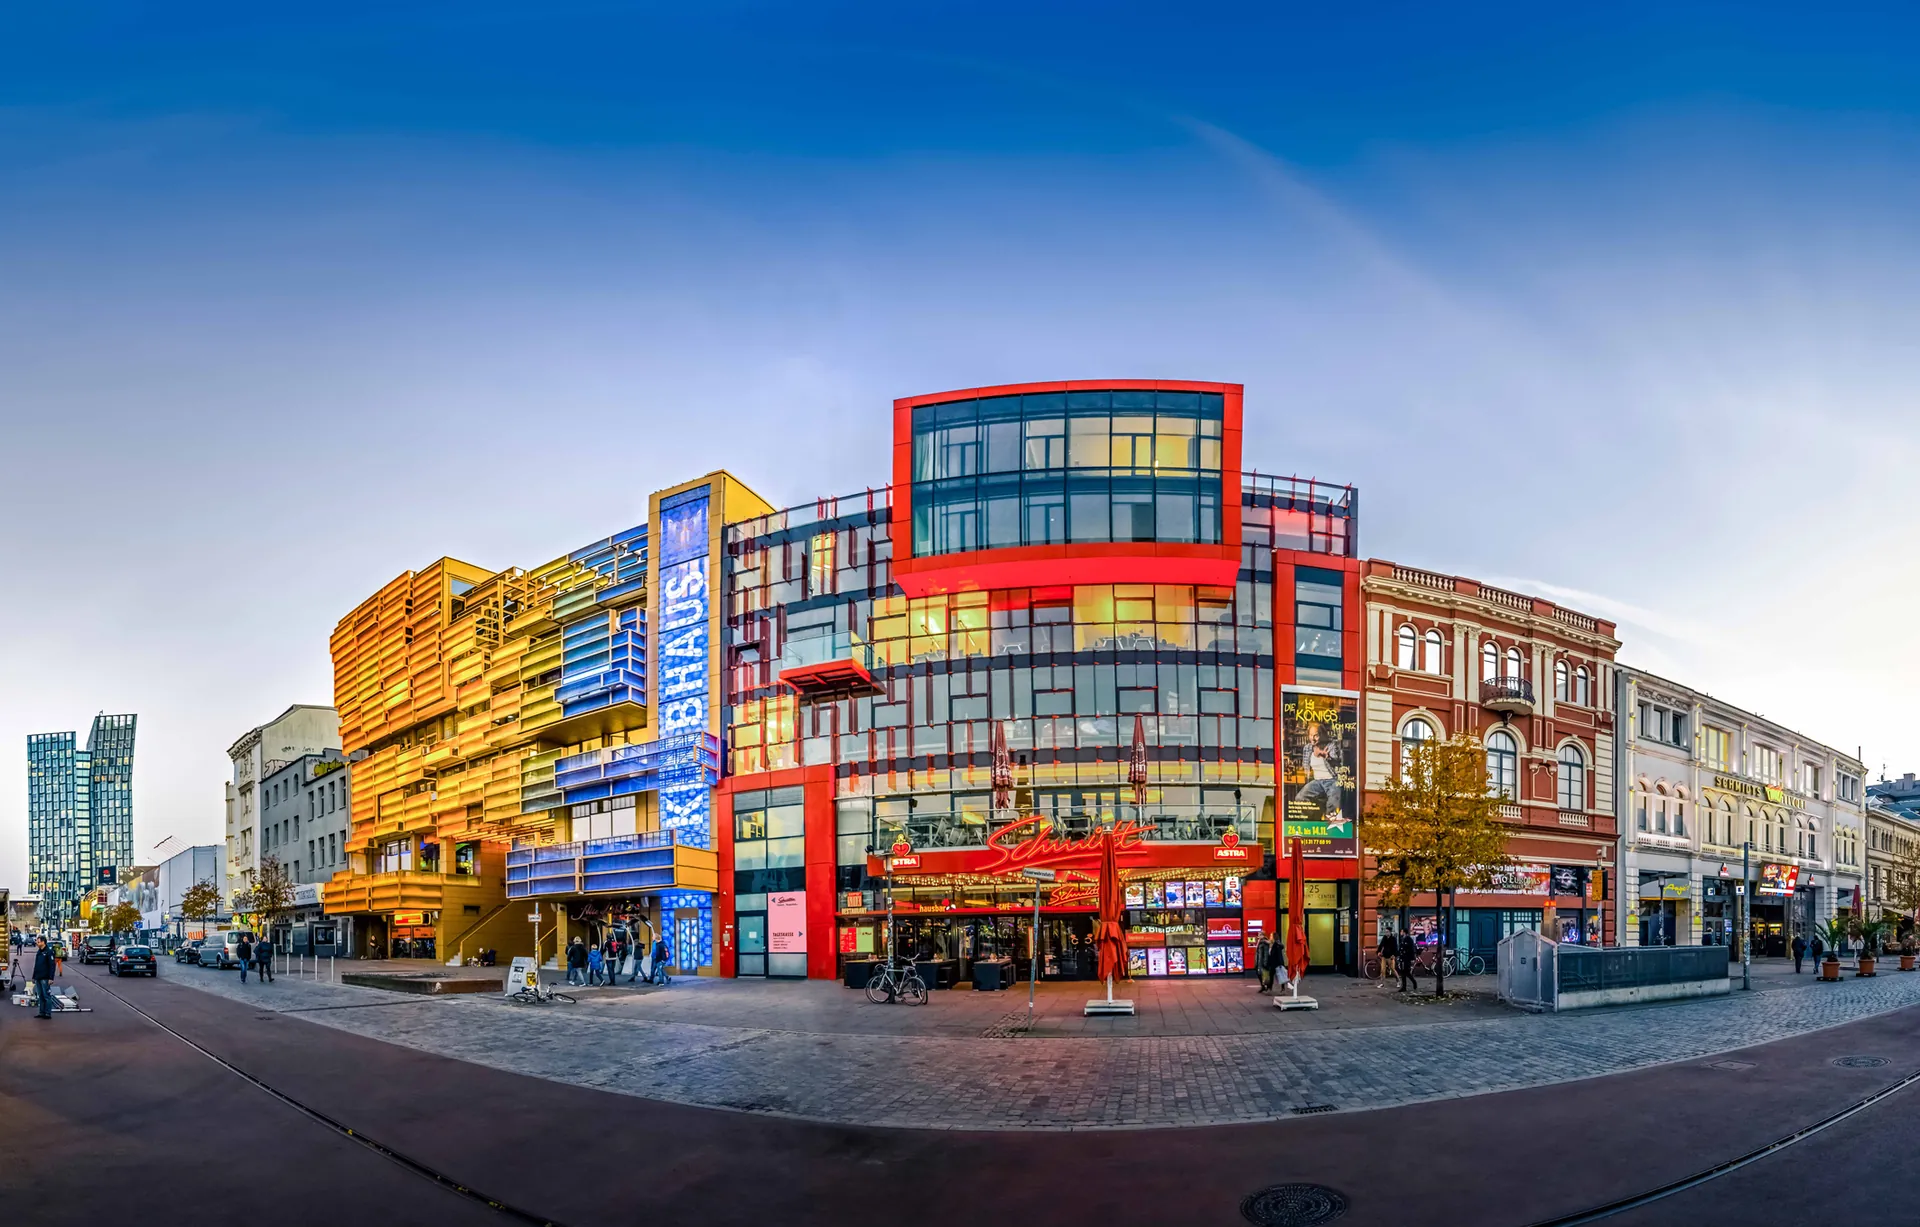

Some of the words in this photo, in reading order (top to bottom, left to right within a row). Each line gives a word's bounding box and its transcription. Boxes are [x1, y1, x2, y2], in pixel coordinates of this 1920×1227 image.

[1715, 775, 1762, 797] SCHMIDTS
[892, 858, 917, 866] STRA
[1309, 885, 1320, 893] 25
[919, 904, 946, 913] hausbar
